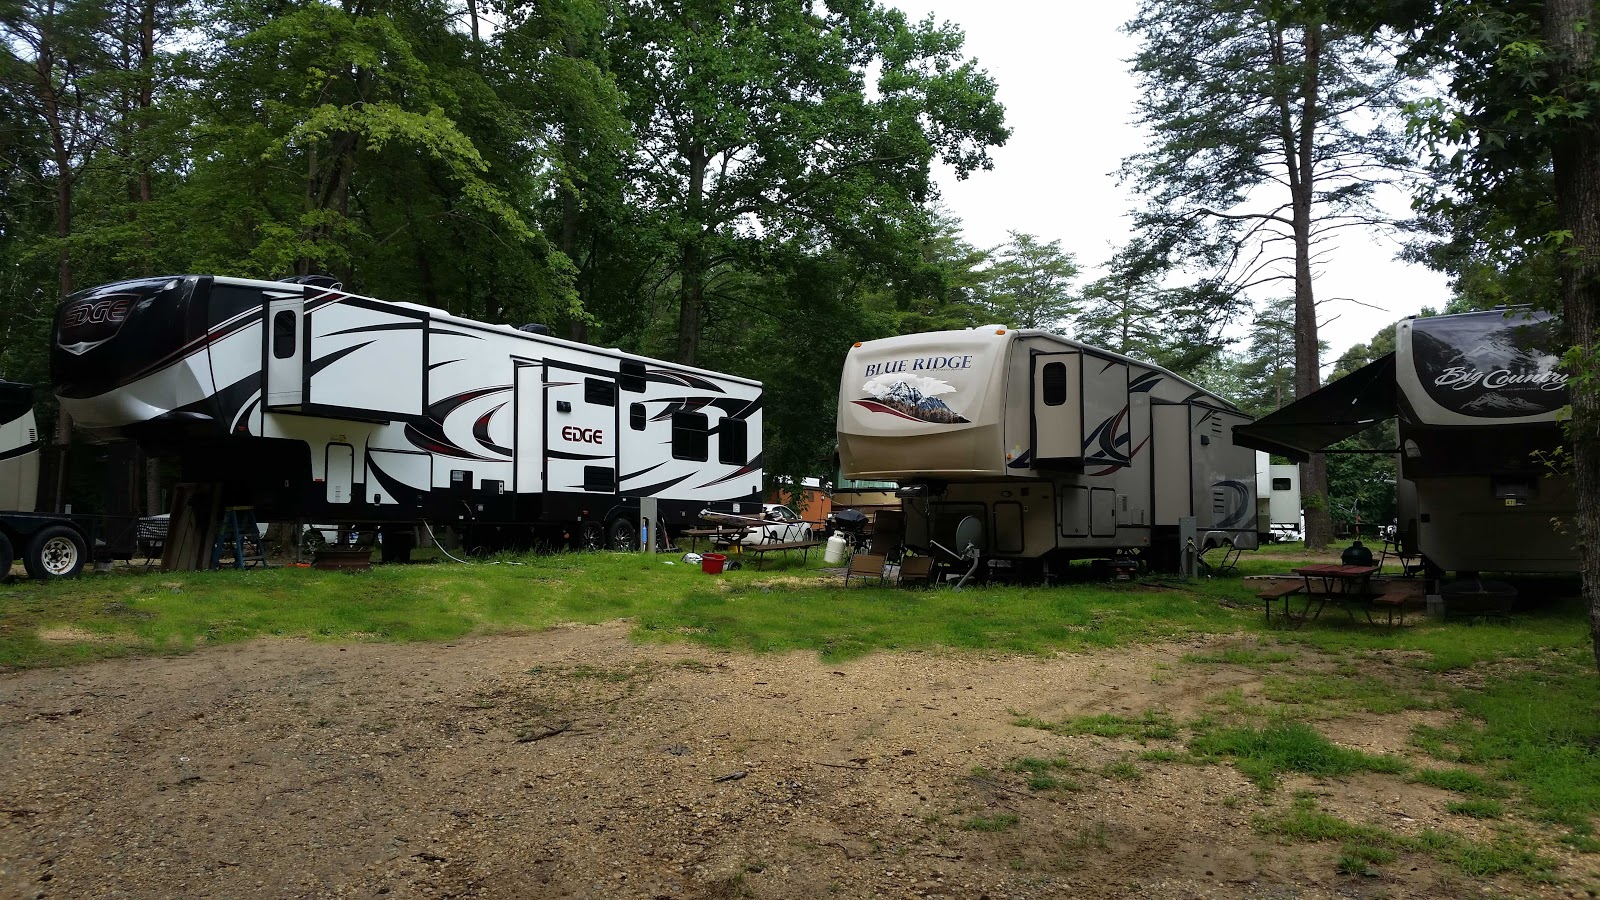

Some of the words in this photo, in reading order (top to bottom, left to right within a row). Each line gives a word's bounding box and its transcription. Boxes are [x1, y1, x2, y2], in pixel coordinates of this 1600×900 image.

[64, 300, 129, 328] EDGE
[865, 360, 908, 377] BLUE
[912, 355, 973, 371] RIDGE
[1434, 366, 1484, 390] Big
[1483, 369, 1569, 391] Country
[561, 425, 603, 445] EDGE
